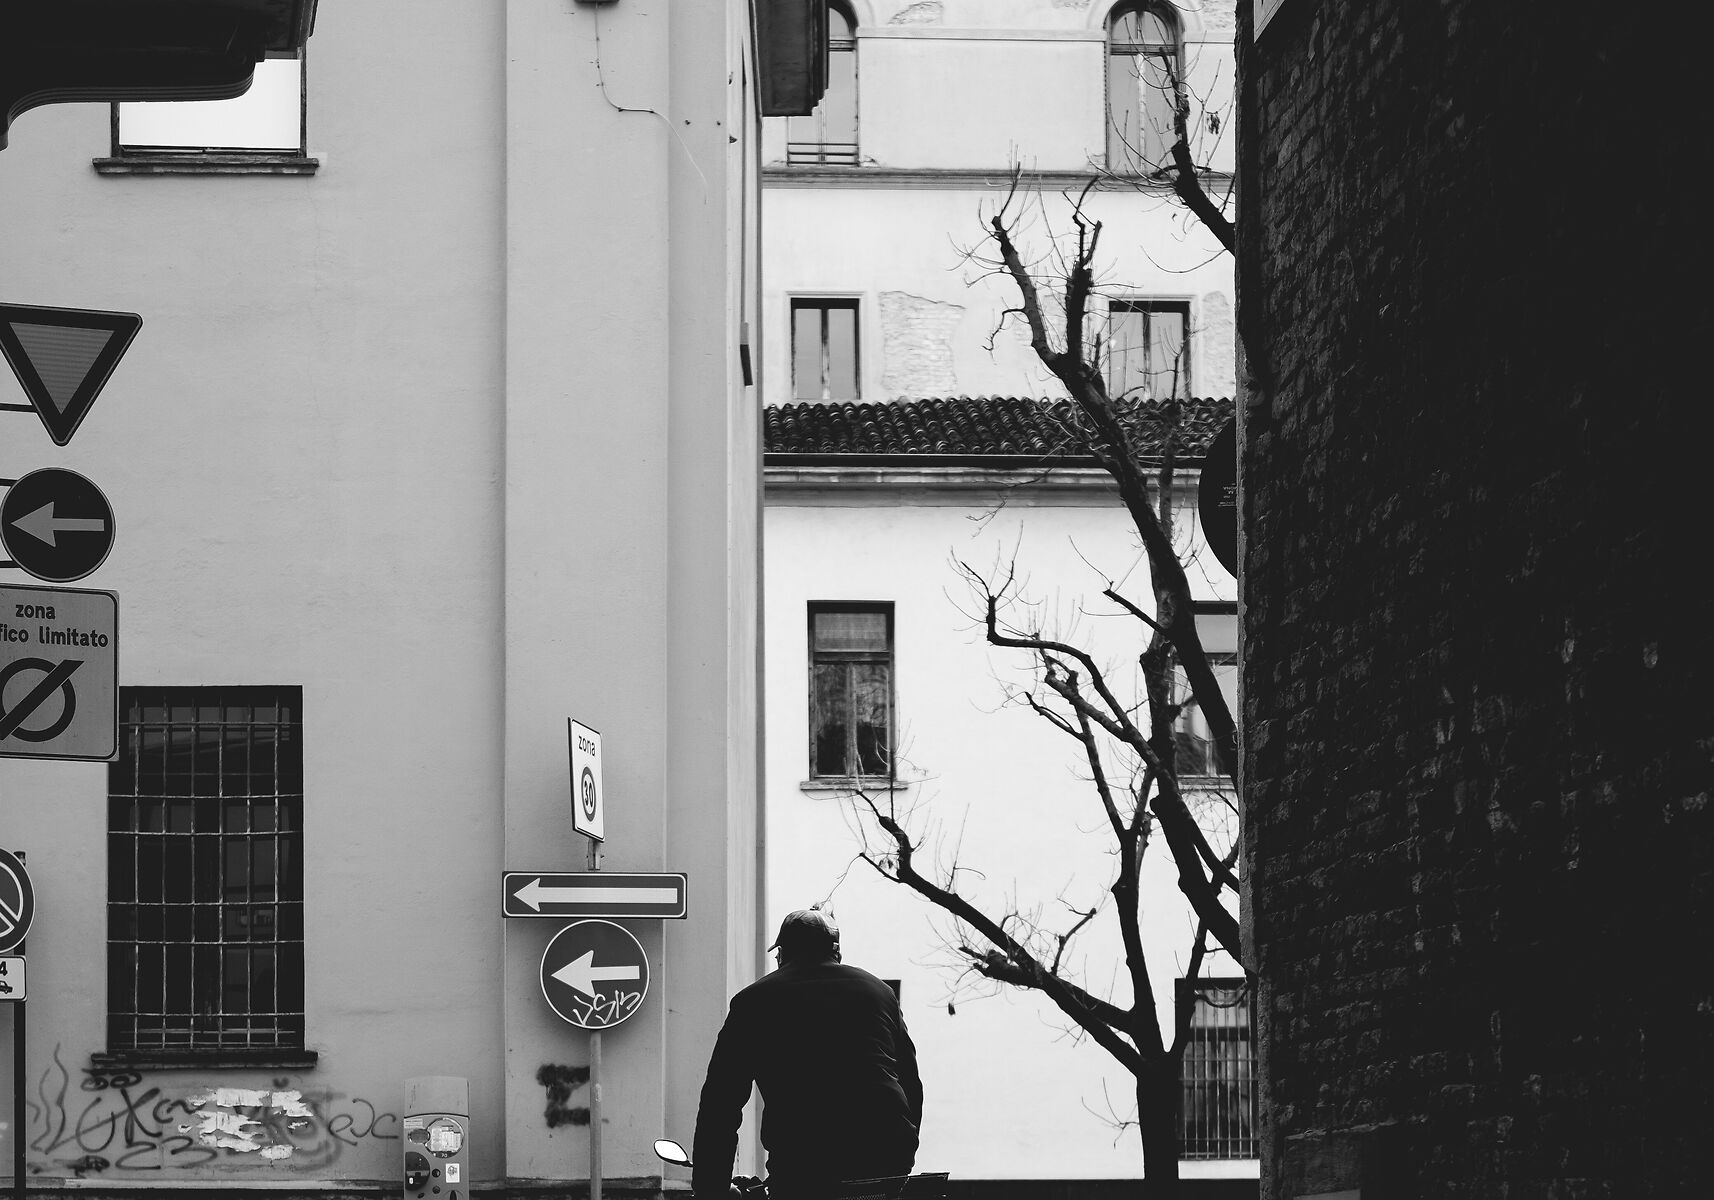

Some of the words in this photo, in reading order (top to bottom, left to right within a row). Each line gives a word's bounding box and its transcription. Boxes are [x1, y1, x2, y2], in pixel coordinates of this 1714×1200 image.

[15, 604, 56, 620] zona
[39, 625, 109, 648] limitato
[578, 735, 596, 757] zona
[584, 780, 594, 808] 30
